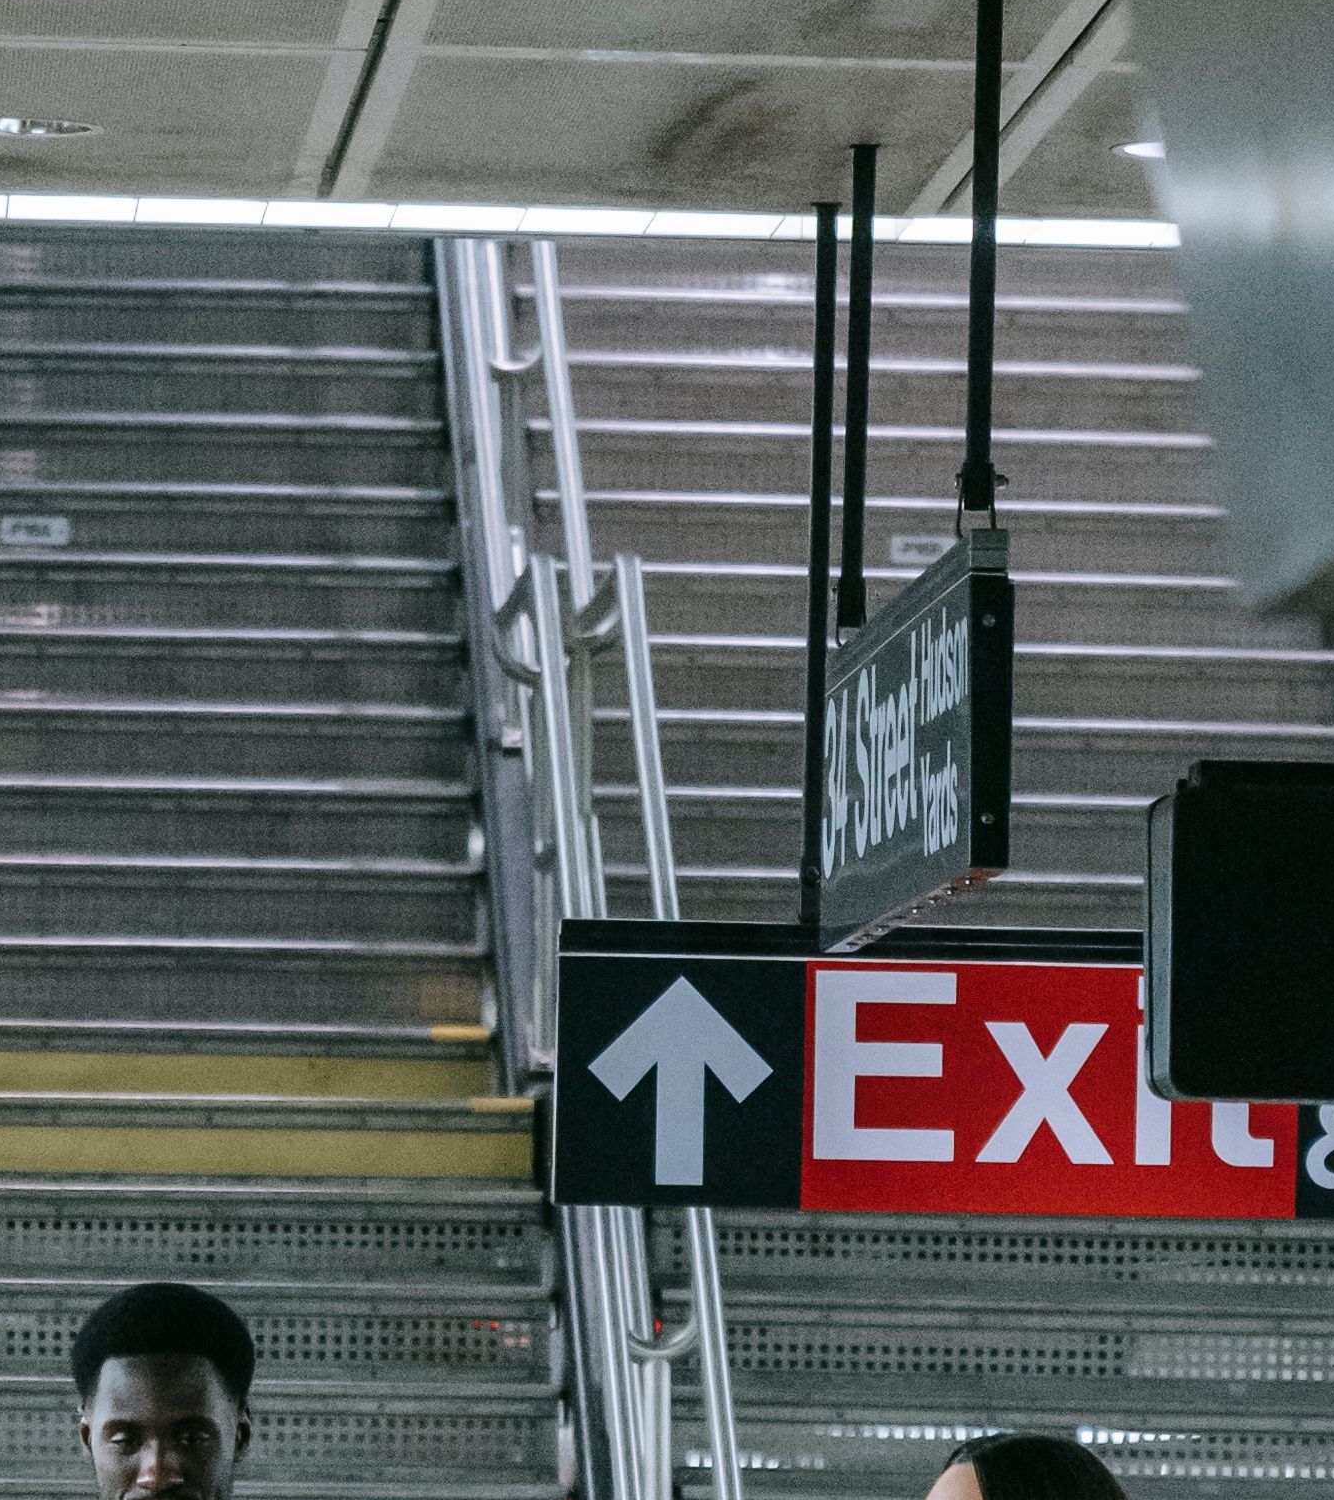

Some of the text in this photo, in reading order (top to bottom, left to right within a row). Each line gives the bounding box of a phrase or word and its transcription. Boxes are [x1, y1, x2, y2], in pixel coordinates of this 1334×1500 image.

[920, 606, 968, 726] Hudson
[822, 629, 918, 880] 34 Street
[920, 740, 959, 858] Yards
